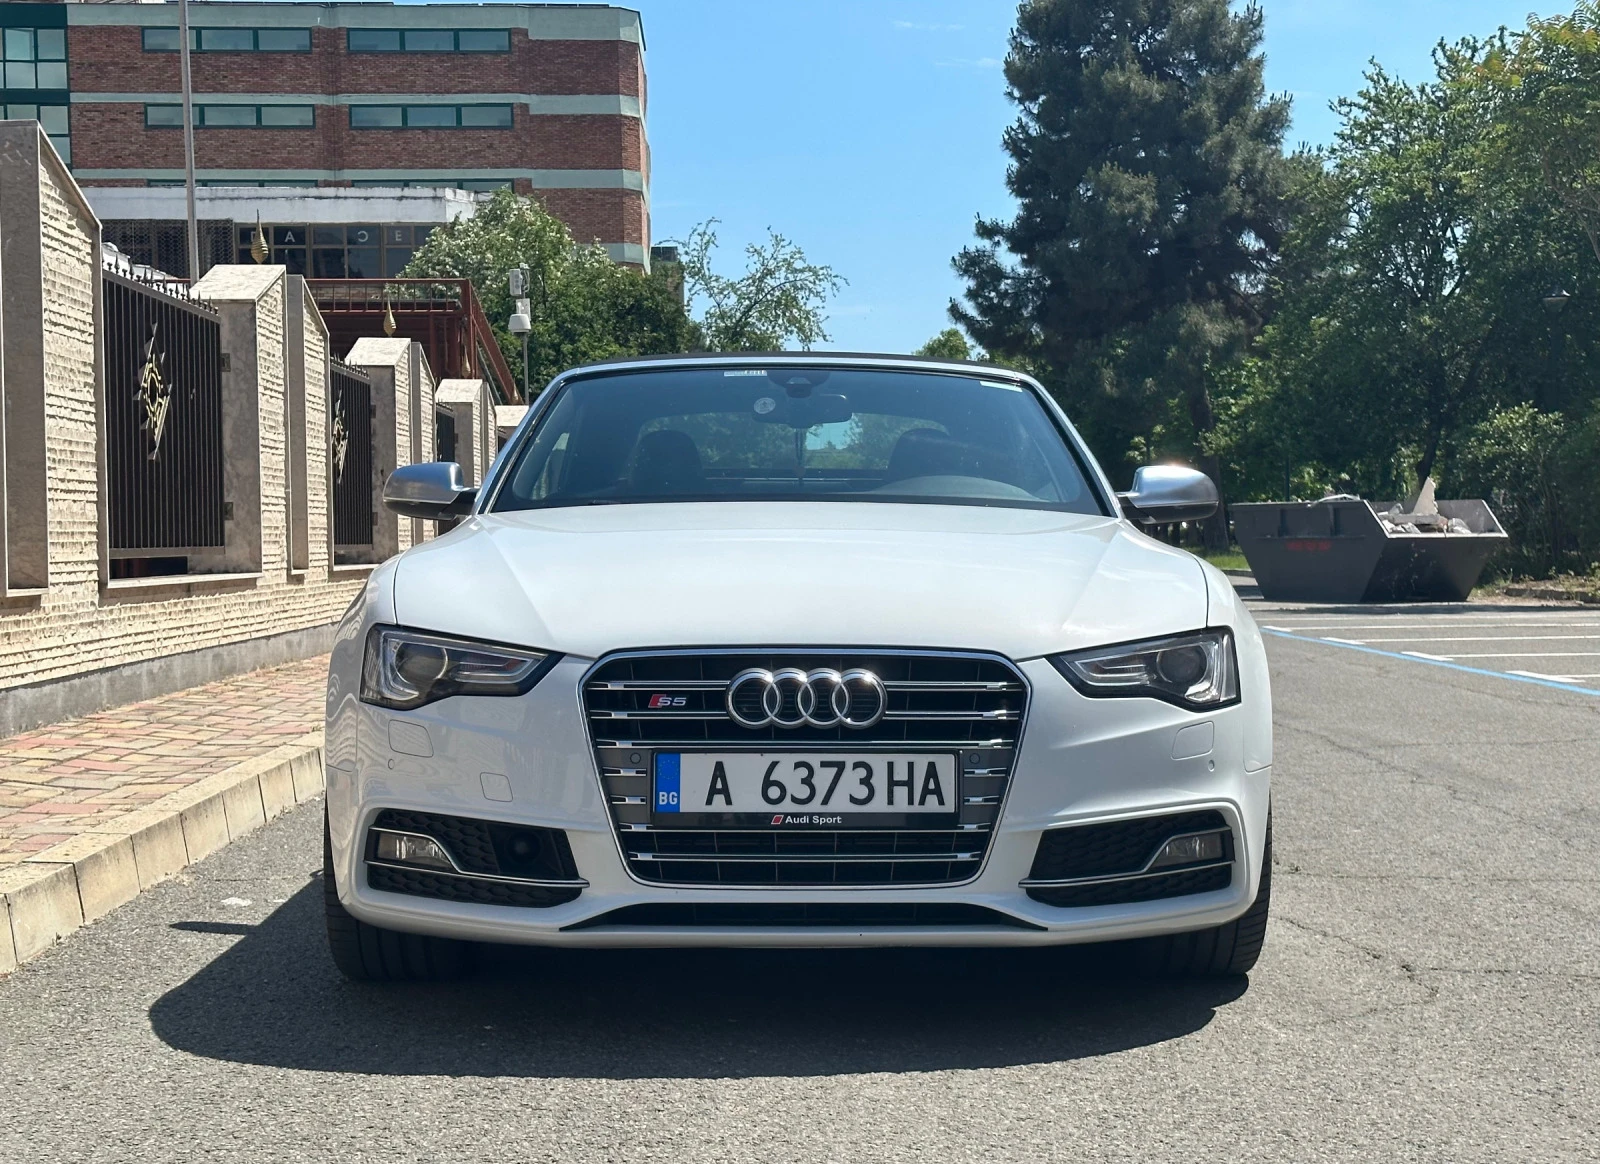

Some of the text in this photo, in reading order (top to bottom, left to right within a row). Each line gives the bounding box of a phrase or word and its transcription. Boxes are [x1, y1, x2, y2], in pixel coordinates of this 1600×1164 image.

[657, 697, 687, 706] S5
[705, 760, 733, 806] A
[761, 760, 875, 806] 6373
[658, 791, 678, 805] BG
[785, 815, 842, 826] Audi Sport
